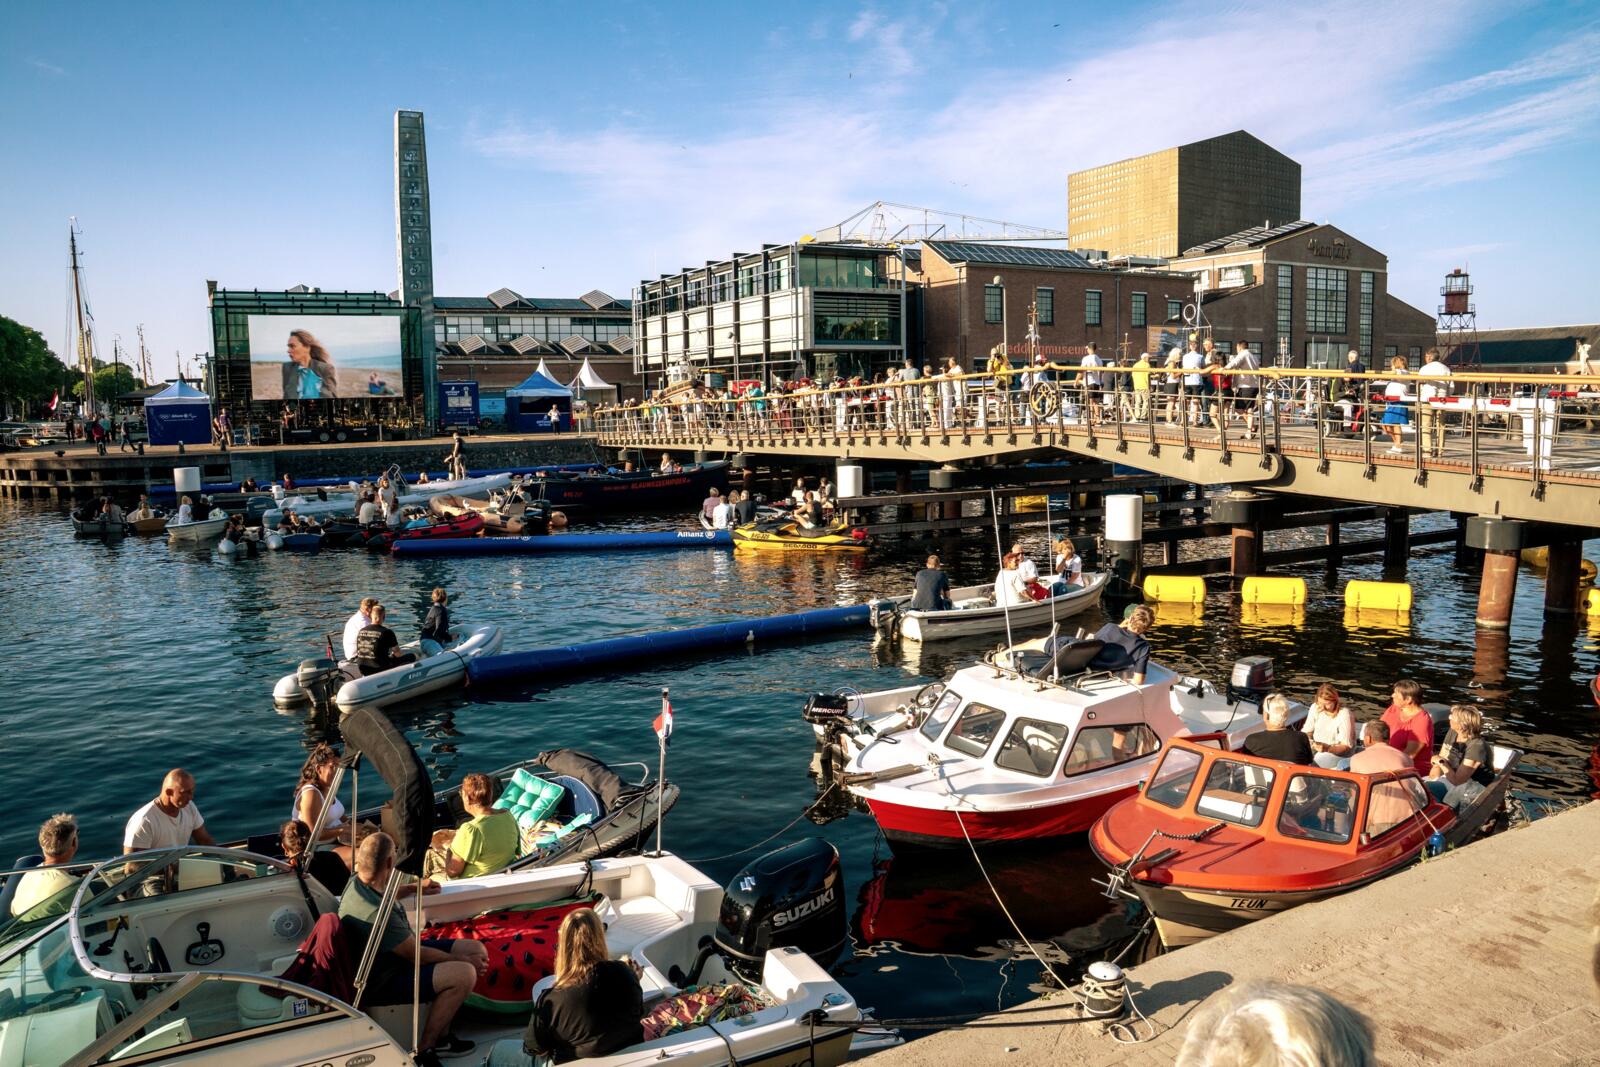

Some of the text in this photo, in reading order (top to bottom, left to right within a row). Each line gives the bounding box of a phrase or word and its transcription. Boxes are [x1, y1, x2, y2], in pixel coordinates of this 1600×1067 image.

[677, 530, 704, 538] Allianz
[773, 887, 834, 927] SUZUKI
[1230, 898, 1268, 909] TEUN
